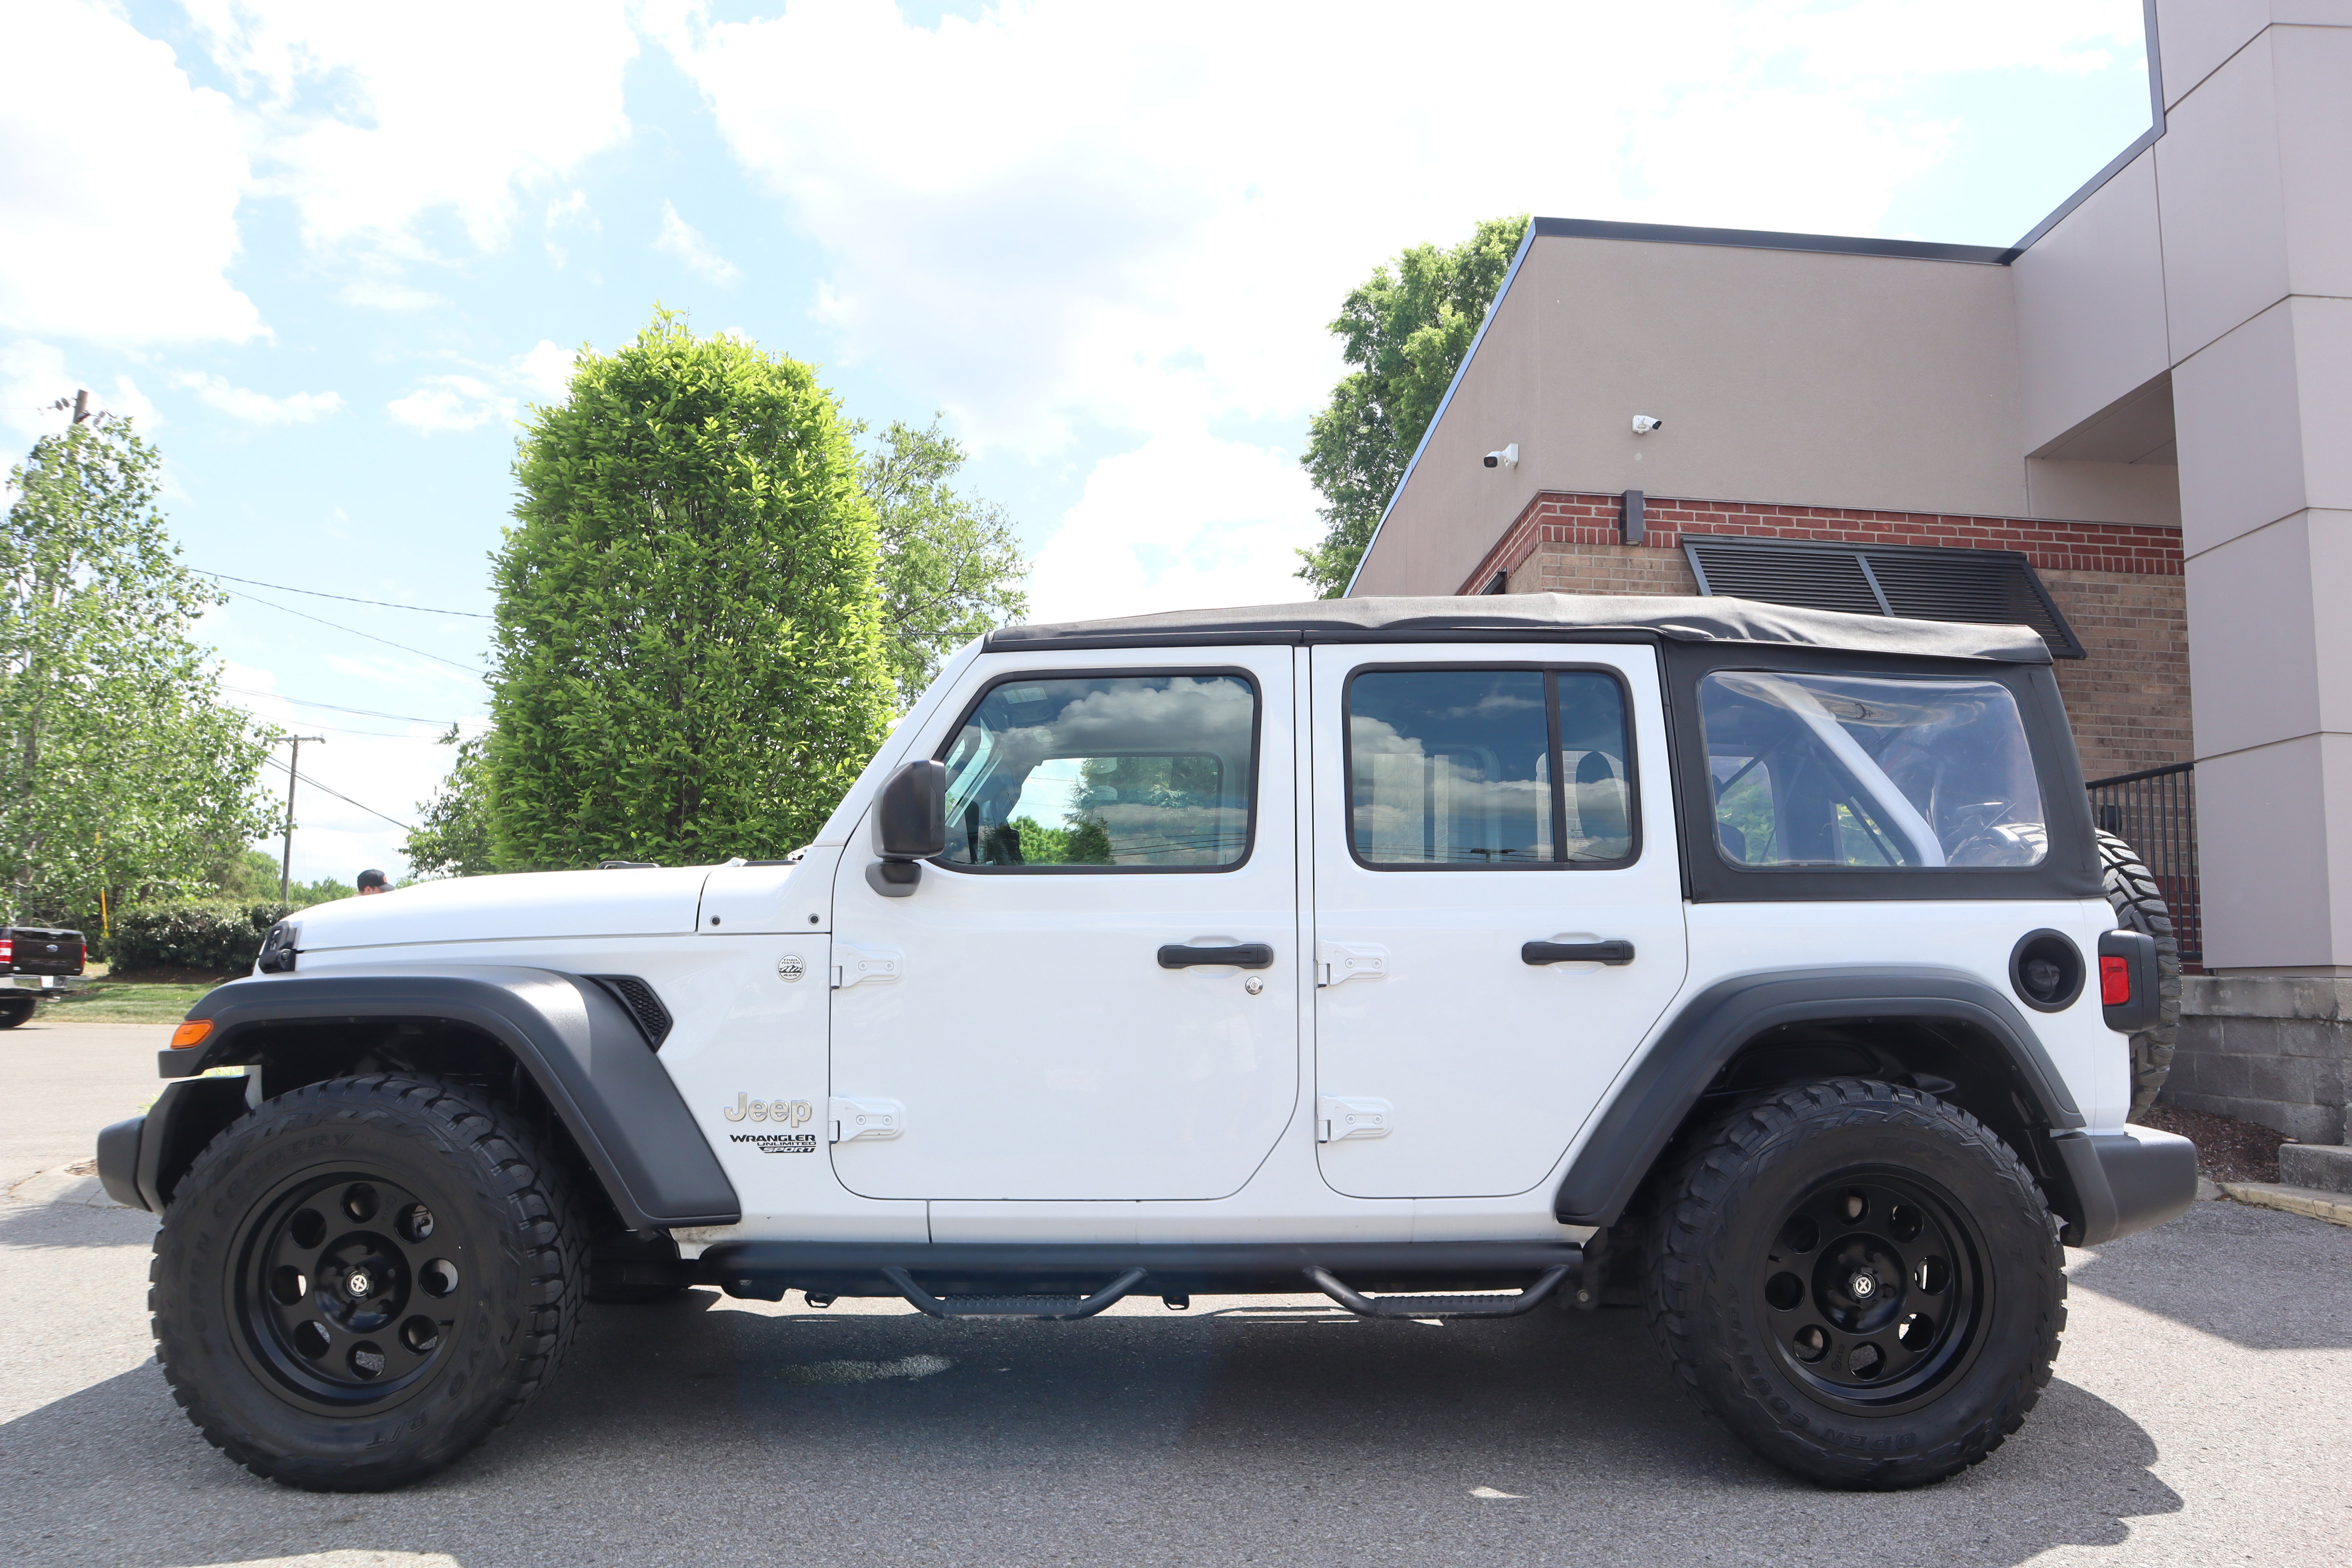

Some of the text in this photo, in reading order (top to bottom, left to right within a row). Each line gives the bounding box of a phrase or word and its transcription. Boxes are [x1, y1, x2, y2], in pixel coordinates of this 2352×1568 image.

[724, 1092, 812, 1128] Jeep
[189, 1132, 355, 1333] OPEN COUNTRY
[448, 1283, 495, 1401] TOYO
[1728, 1282, 1918, 1451] OPEN COUNTRY
[365, 1409, 427, 1449] R/T
